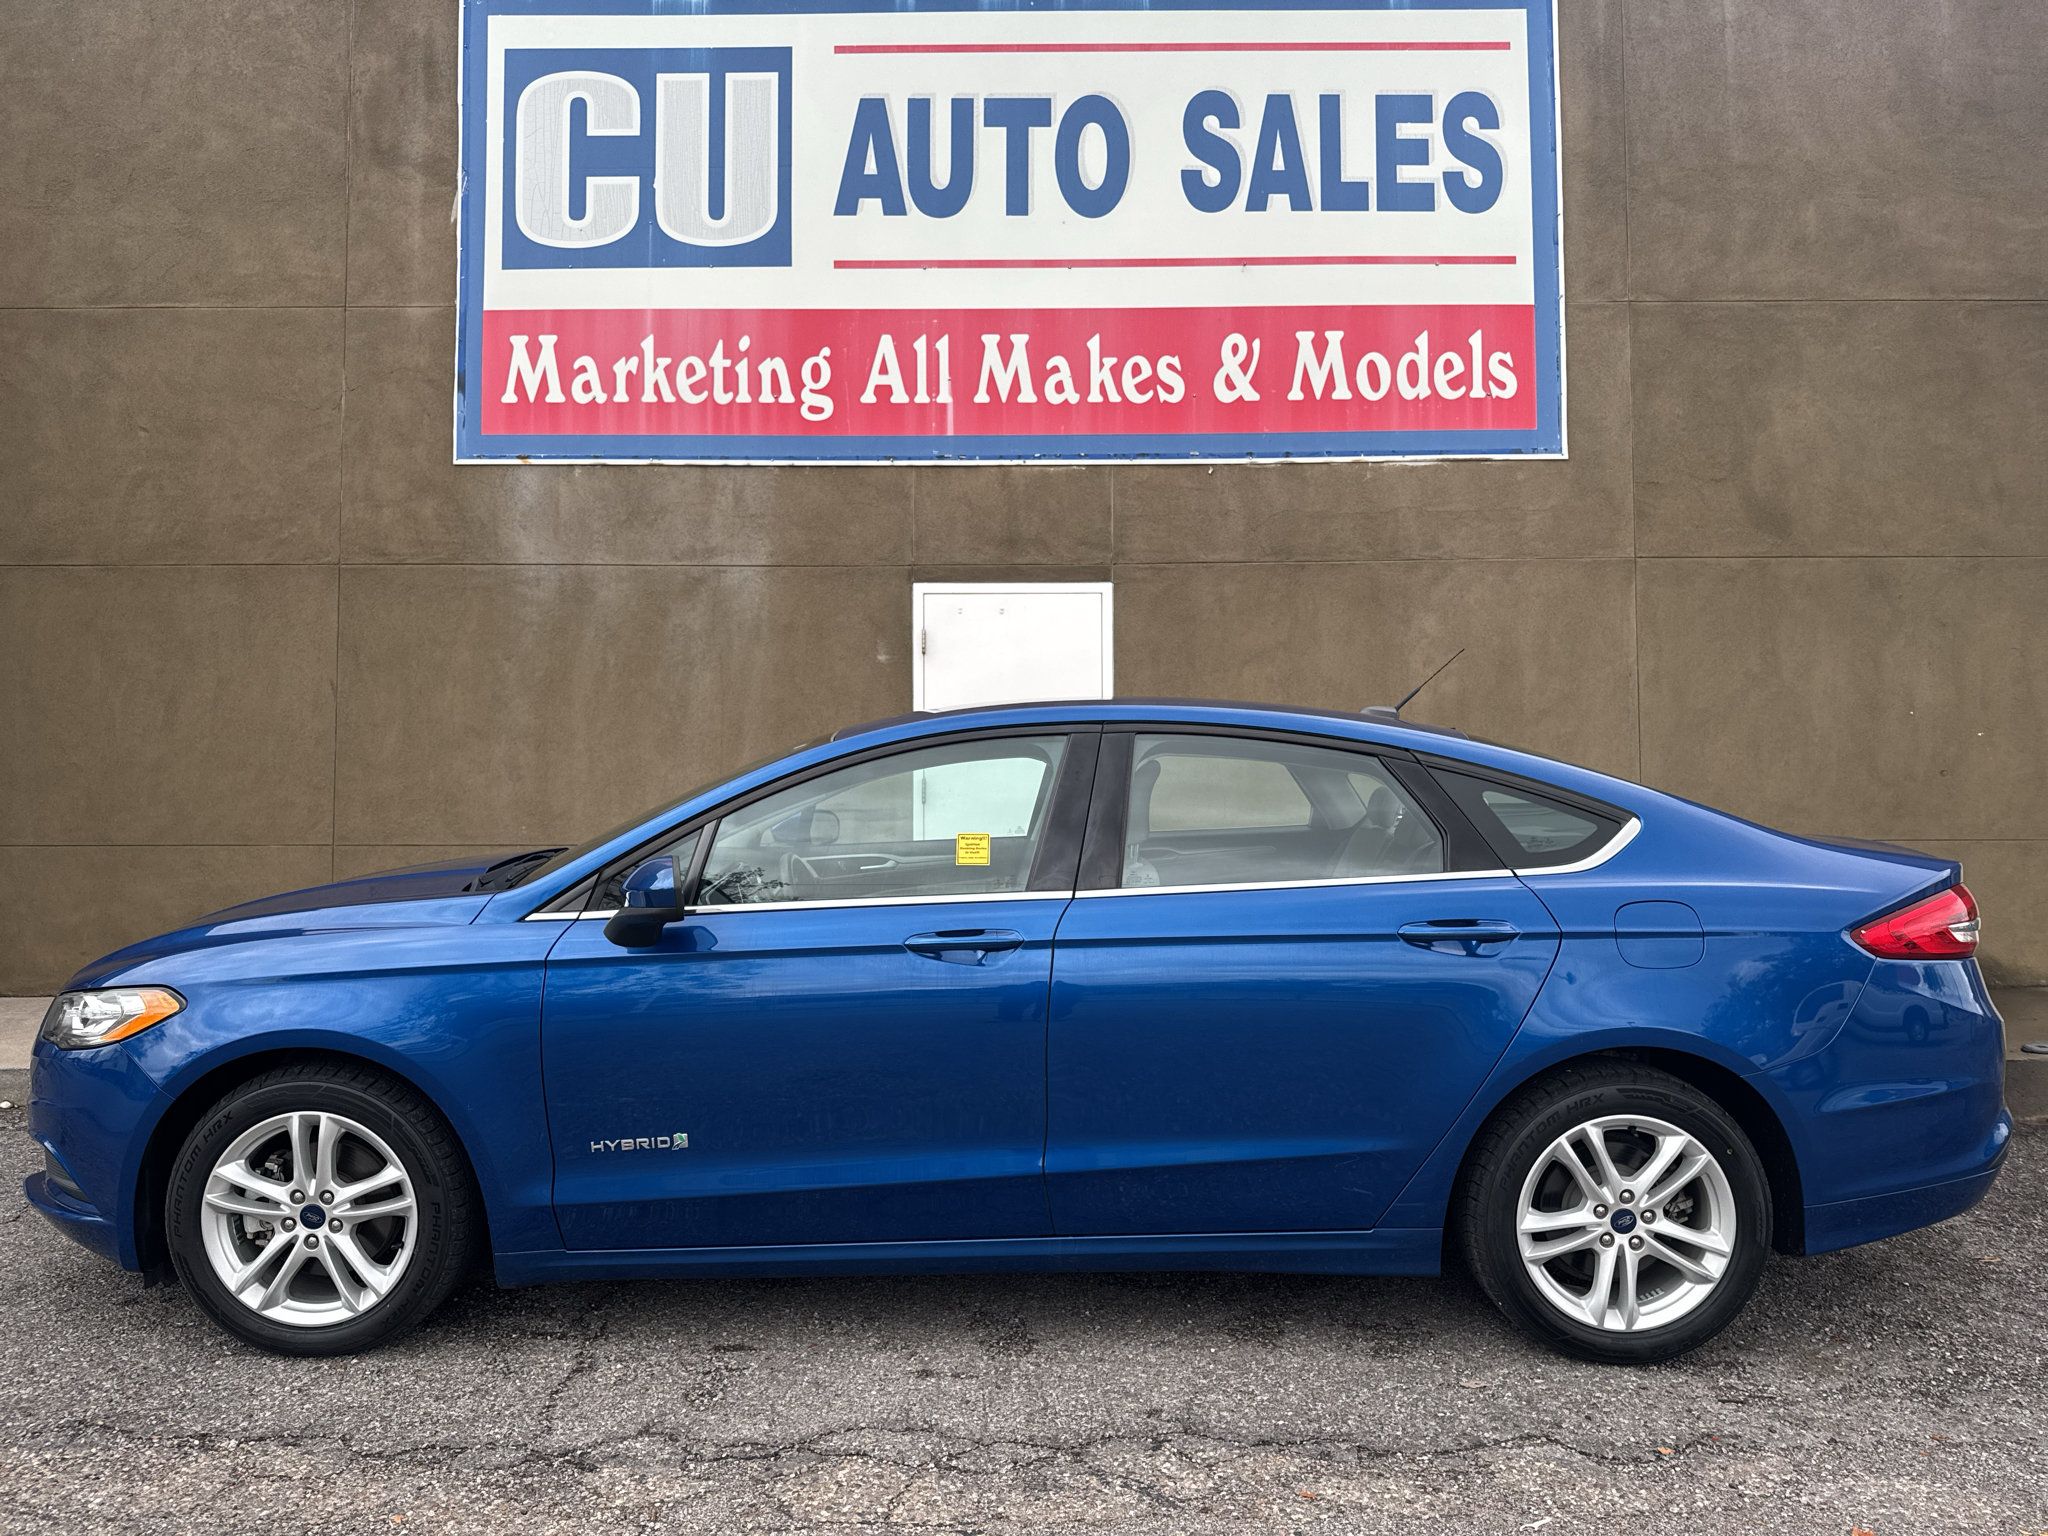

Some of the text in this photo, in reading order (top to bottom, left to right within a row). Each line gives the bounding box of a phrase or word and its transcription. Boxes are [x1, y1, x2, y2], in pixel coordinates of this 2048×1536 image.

[515, 70, 1503, 248] CU AUTO SALES
[500, 328, 1518, 422] Marketing All Makes & Models
[172, 1110, 234, 1239] PHANTOM HRX
[590, 1136, 671, 1152] HYBRID
